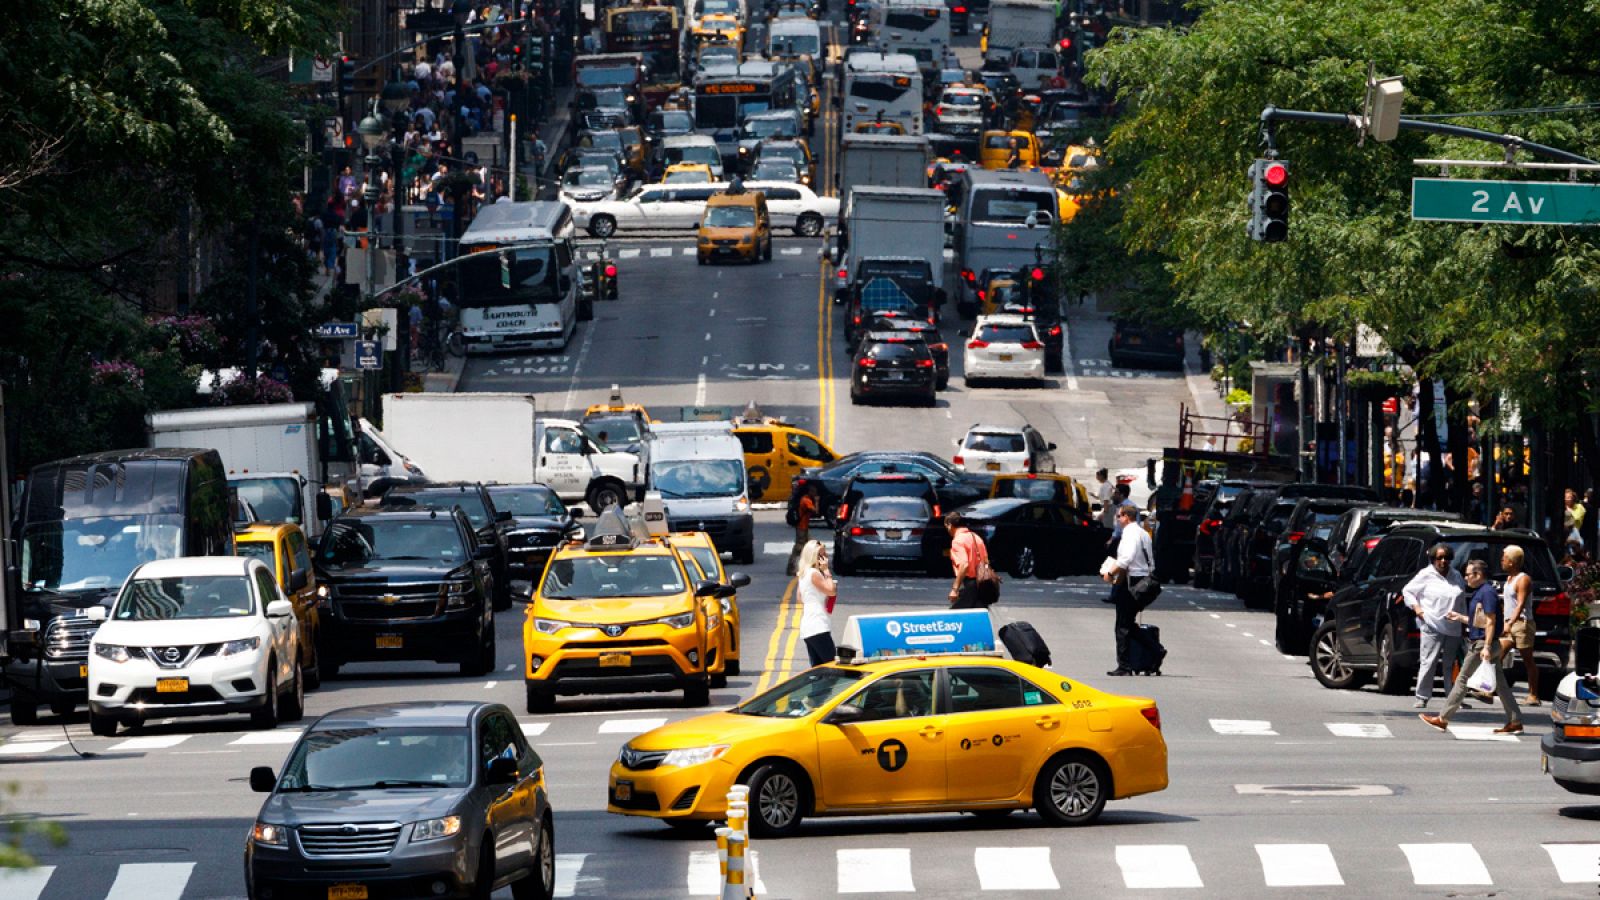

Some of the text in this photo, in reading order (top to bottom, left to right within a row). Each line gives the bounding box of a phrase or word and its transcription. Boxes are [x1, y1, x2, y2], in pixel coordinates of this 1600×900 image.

[1472, 190, 1544, 214] 2 Av
[903, 621, 963, 634] StreetEasy
